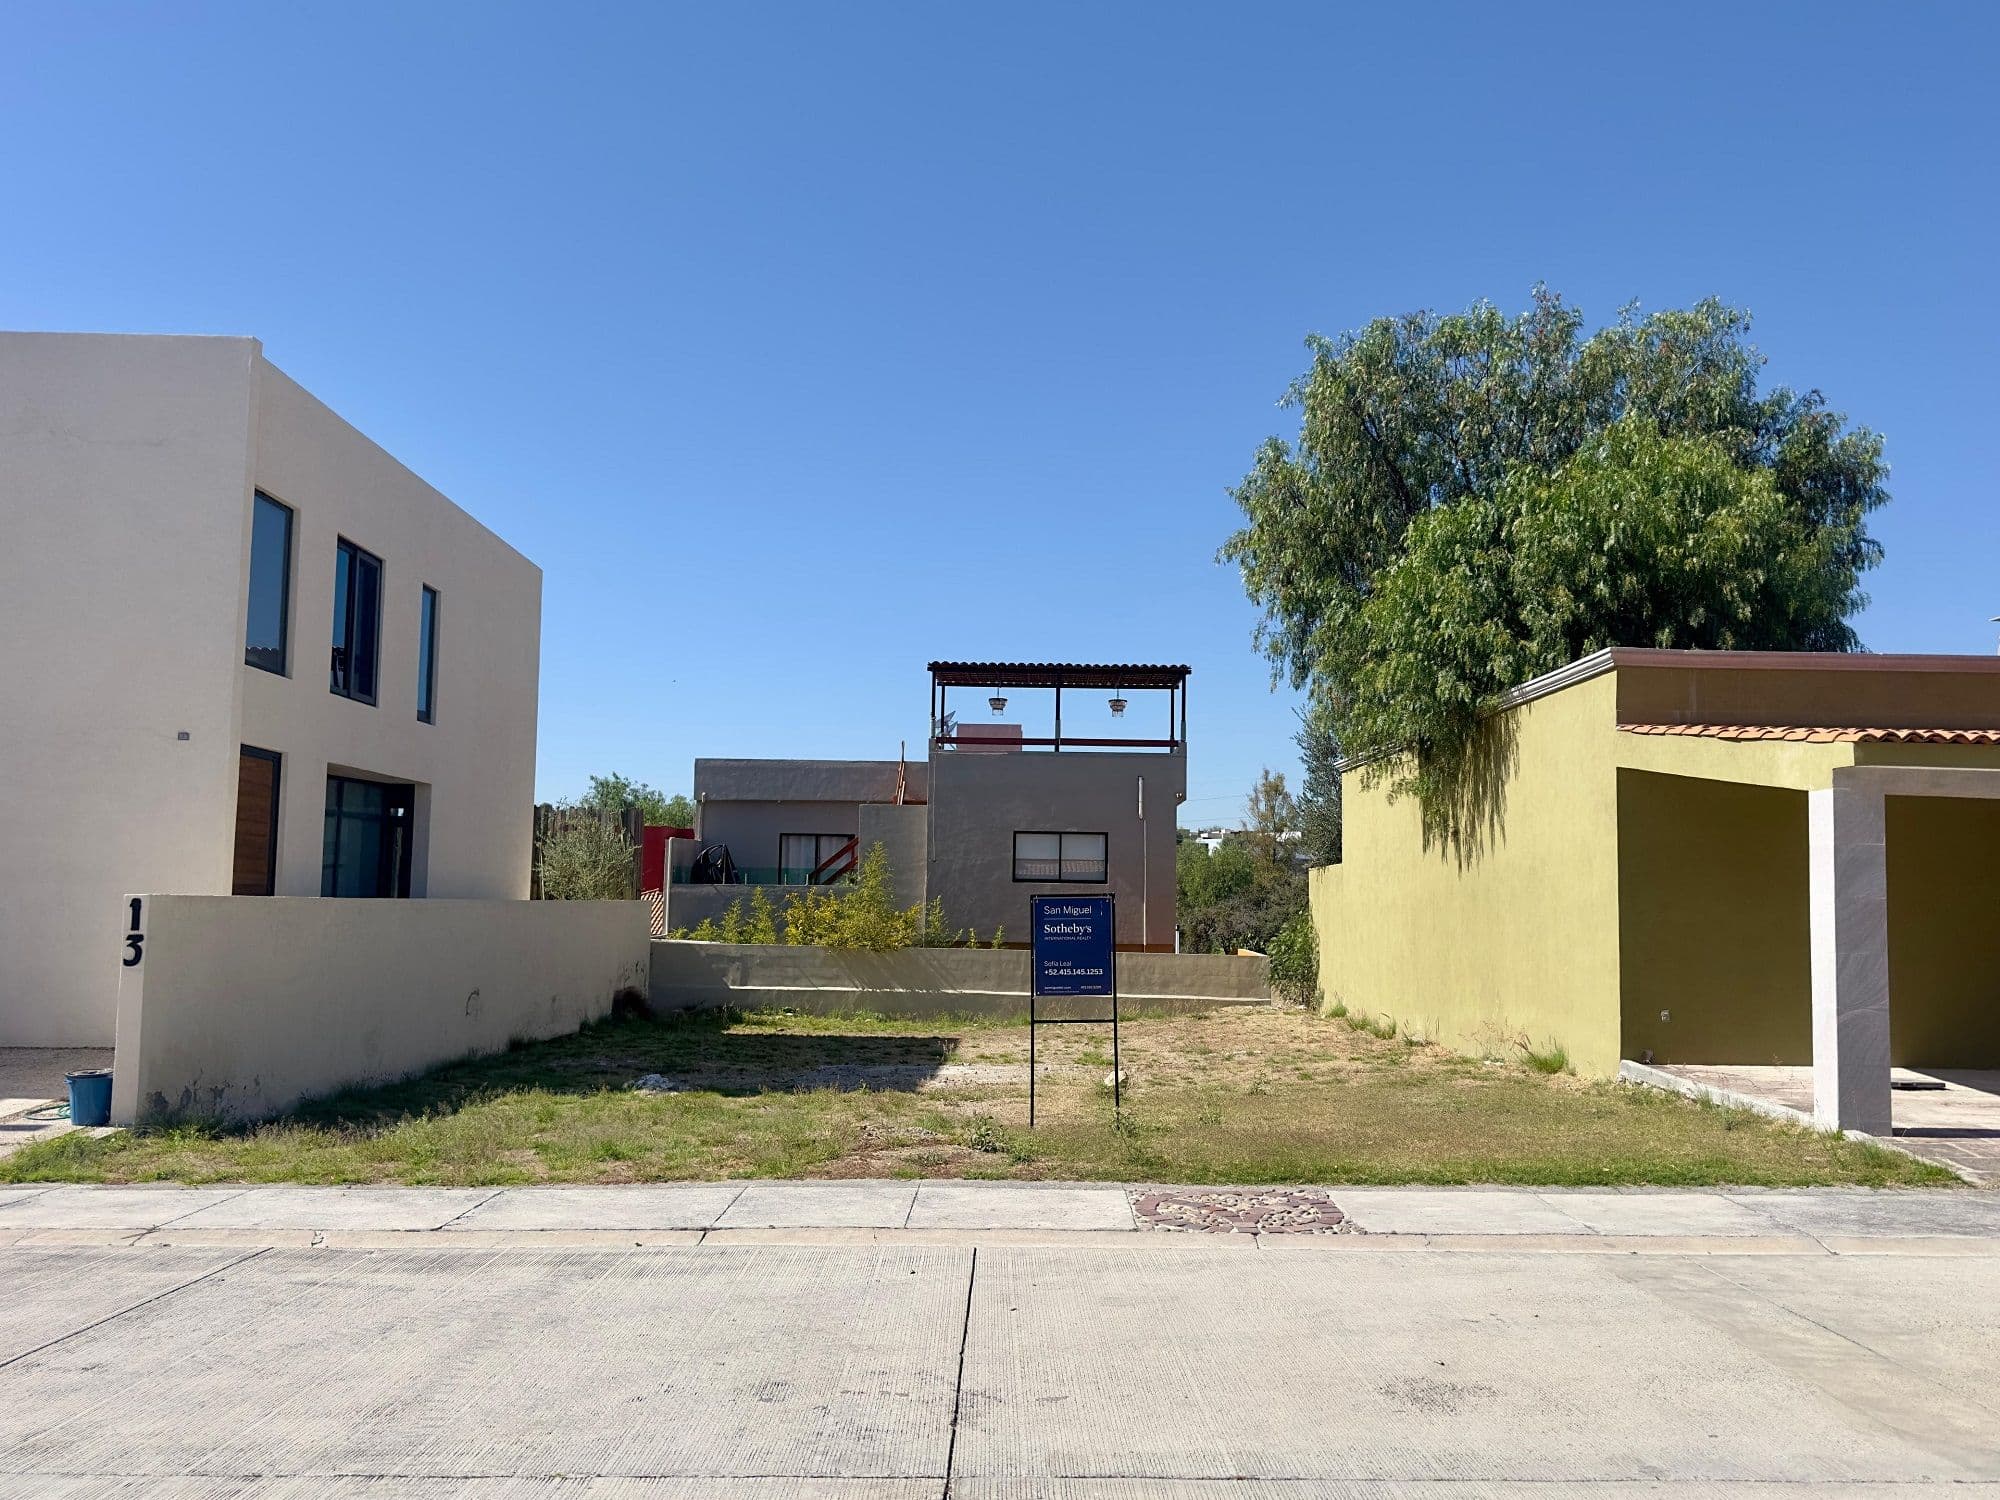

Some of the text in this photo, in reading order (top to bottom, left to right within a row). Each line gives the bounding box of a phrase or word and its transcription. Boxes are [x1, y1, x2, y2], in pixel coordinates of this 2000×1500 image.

[1043, 905, 1092, 916] San Miguel
[1044, 922, 1092, 935] Sotheby's
